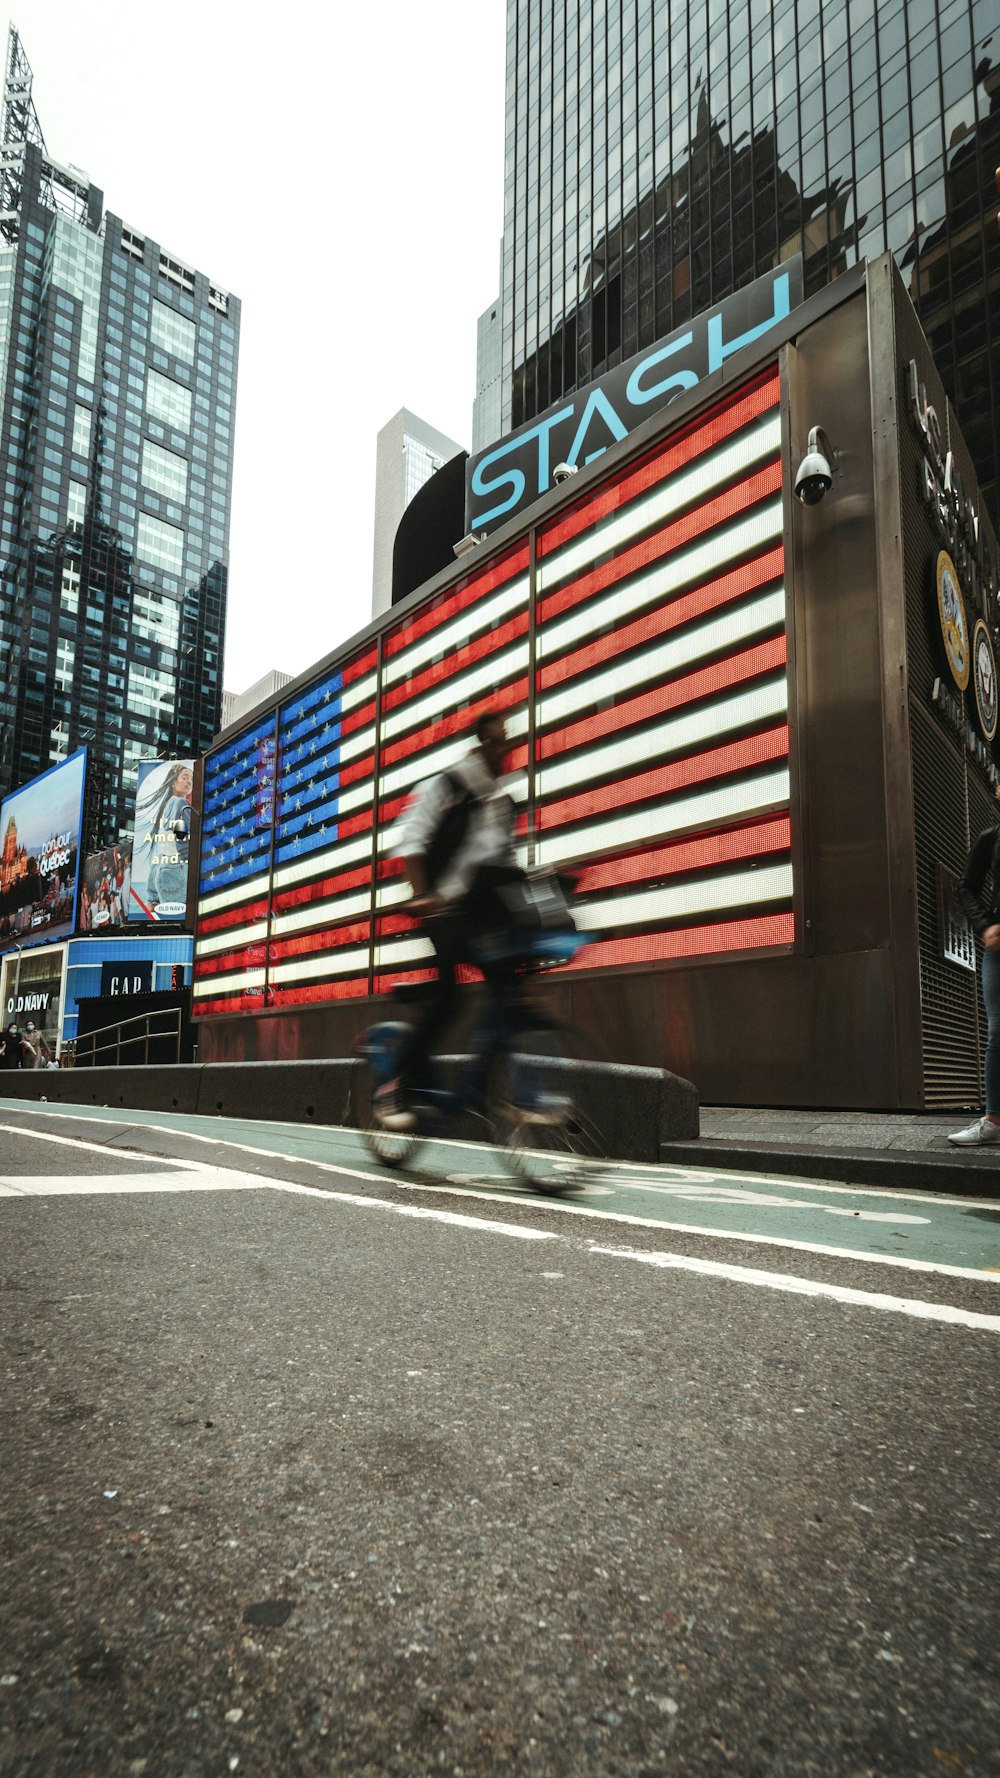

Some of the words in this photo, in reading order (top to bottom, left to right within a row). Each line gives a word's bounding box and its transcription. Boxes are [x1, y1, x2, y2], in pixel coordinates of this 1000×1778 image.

[472, 272, 789, 530] STASH
[110, 976, 141, 996] GAP
[8, 996, 24, 1013] OD
[24, 993, 49, 1011] NAVY
